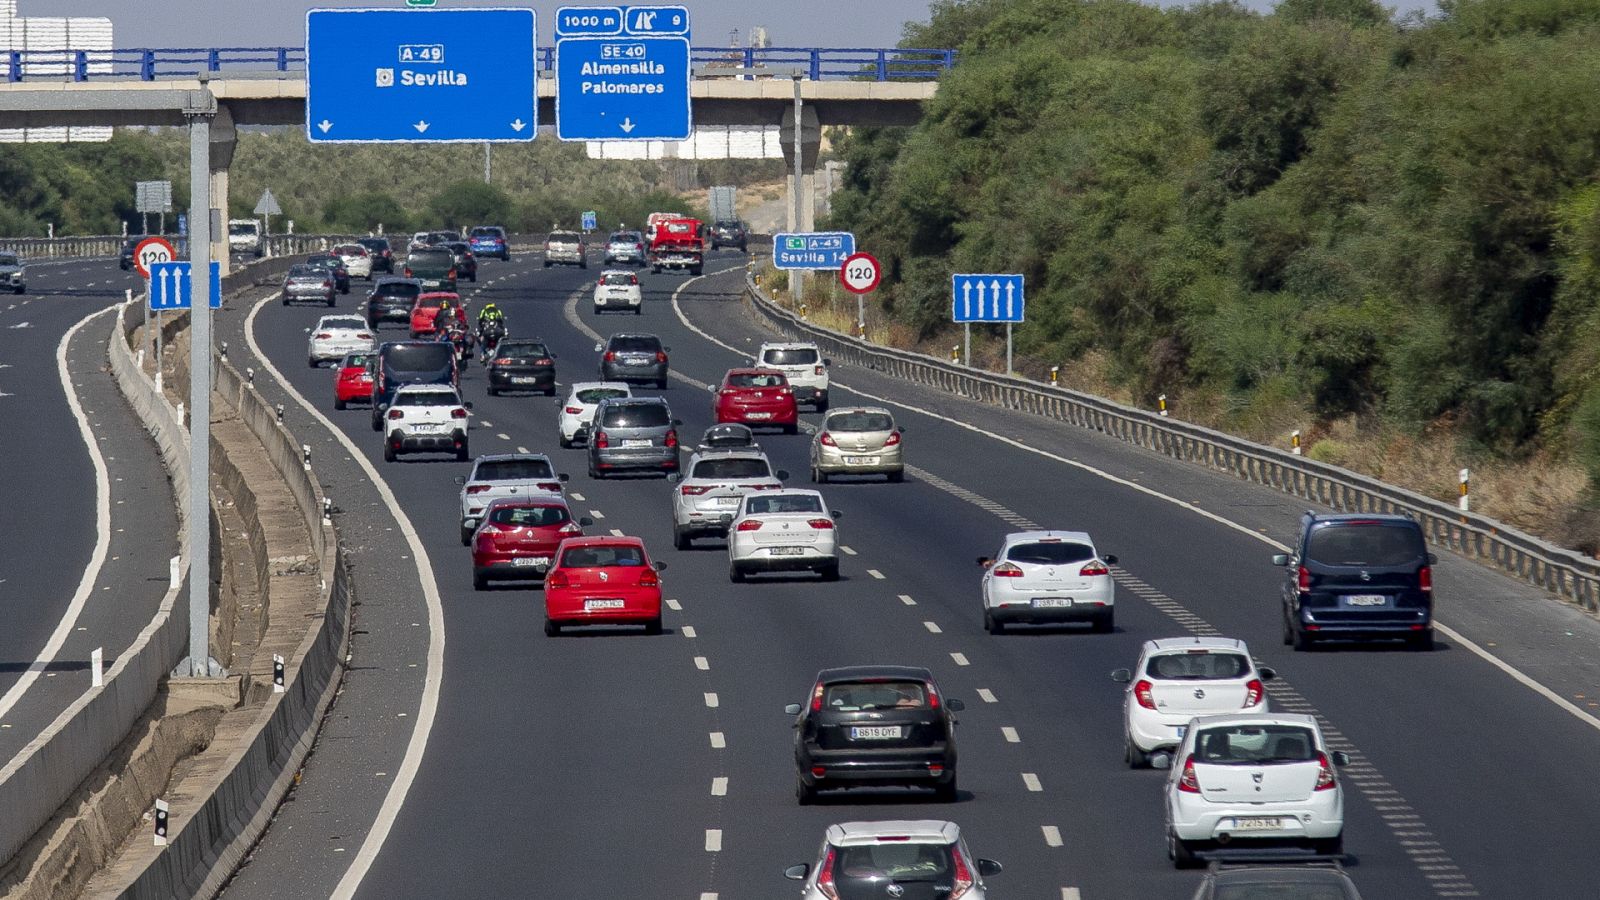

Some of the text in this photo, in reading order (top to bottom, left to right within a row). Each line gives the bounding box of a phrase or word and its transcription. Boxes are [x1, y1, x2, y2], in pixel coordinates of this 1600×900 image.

[565, 16, 614, 26] 1000 m
[673, 15, 680, 25] 9
[402, 47, 441, 60] A-49
[603, 46, 643, 57] SE-40
[582, 61, 664, 75] Almensilla
[401, 70, 467, 85] Sevilla
[582, 80, 664, 94] Palomares
[810, 239, 840, 247] A-49
[142, 251, 168, 265] 120
[781, 252, 847, 262] Sevilla 14
[849, 267, 872, 279] 120
